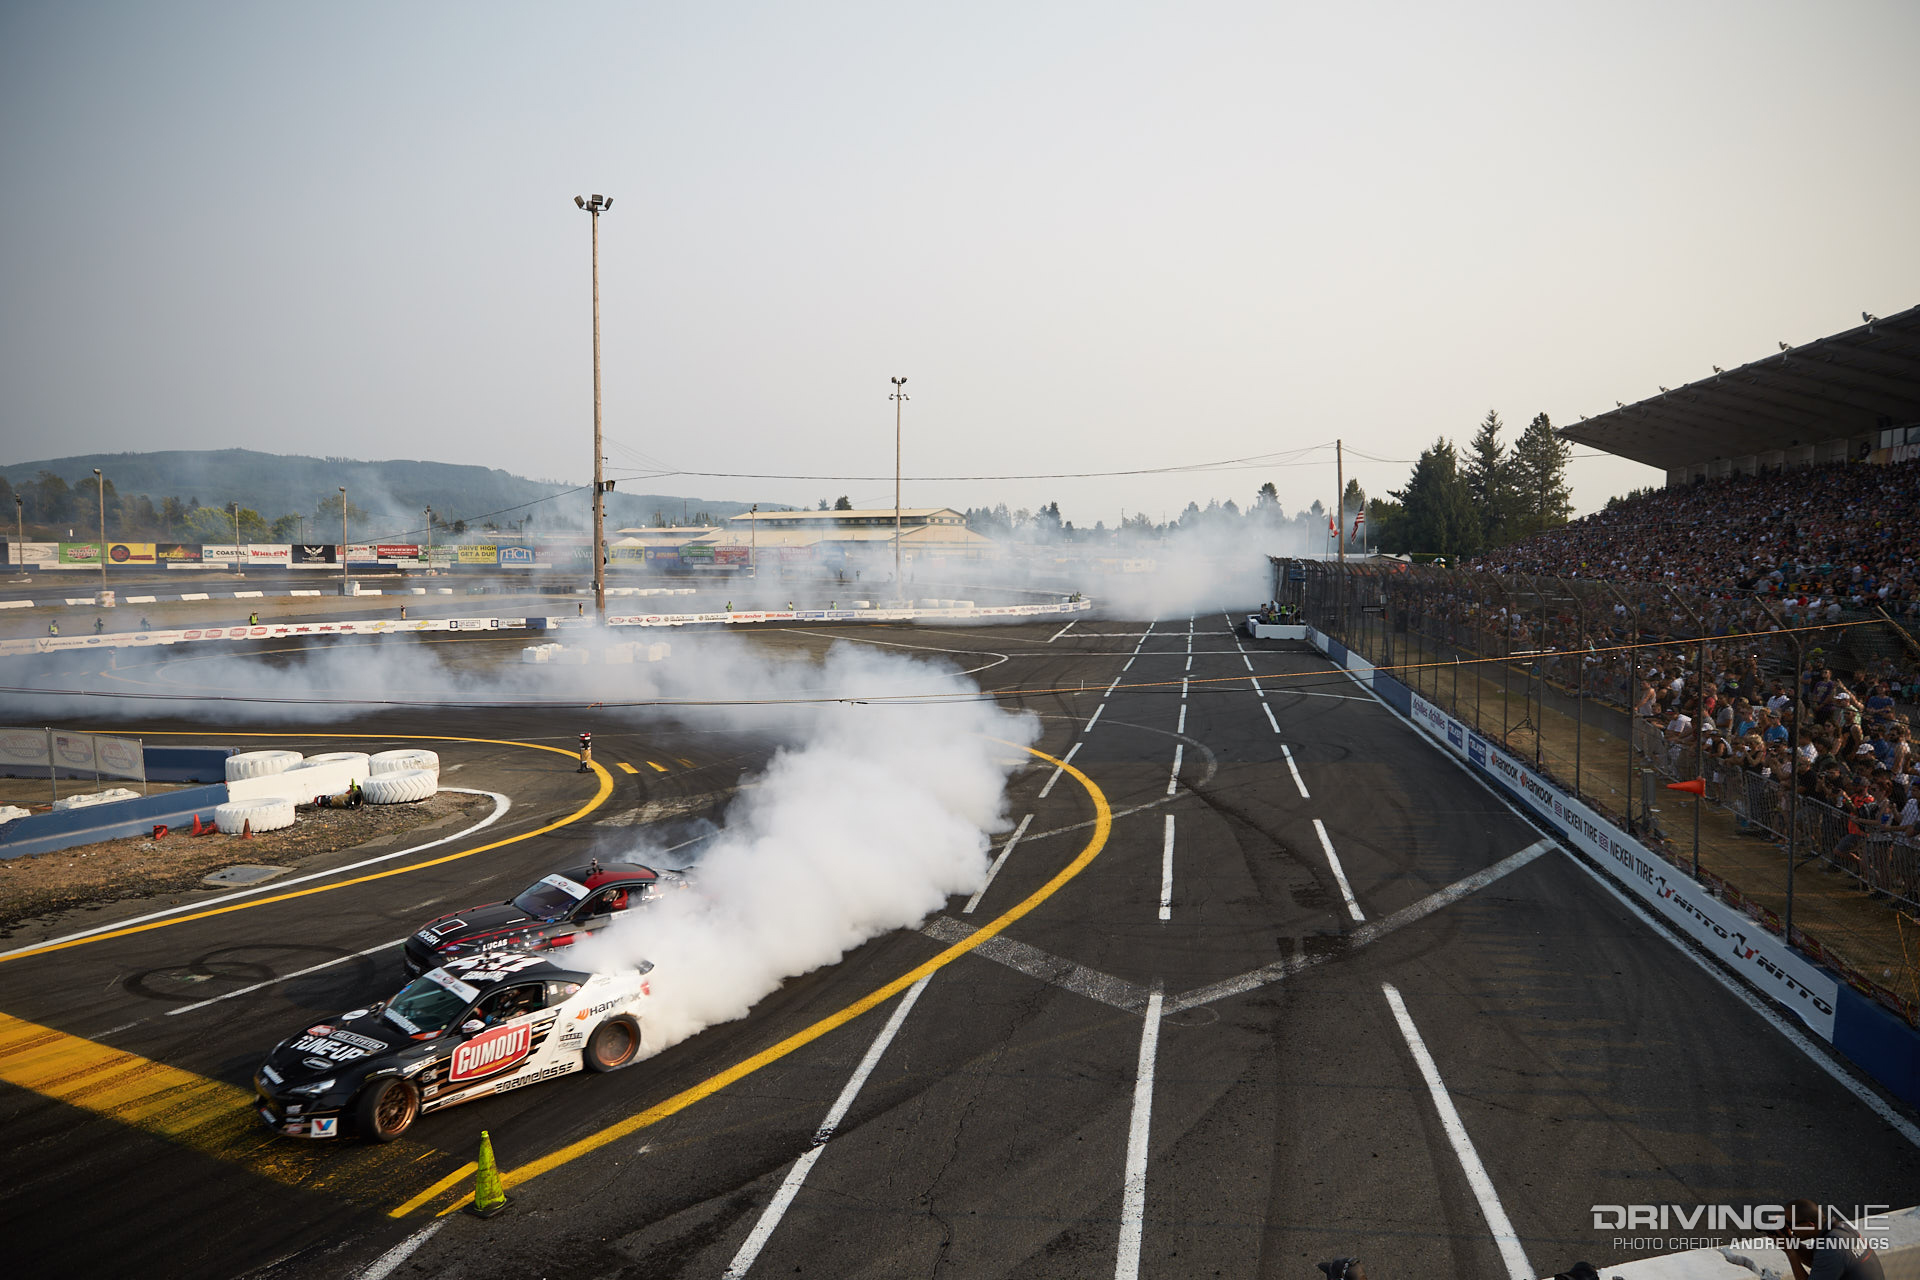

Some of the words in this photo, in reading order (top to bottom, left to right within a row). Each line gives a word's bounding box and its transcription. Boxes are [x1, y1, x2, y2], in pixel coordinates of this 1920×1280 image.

[1563, 806, 1583, 833] NEXEN
[1583, 820, 1598, 844] TIRE
[1609, 840, 1635, 871] NEXEN
[1635, 857, 1654, 885] TIRE
[482, 938, 508, 951] LUCAS
[290, 1034, 366, 1063] TUNE-UP
[456, 1027, 527, 1076] GUMOUT
